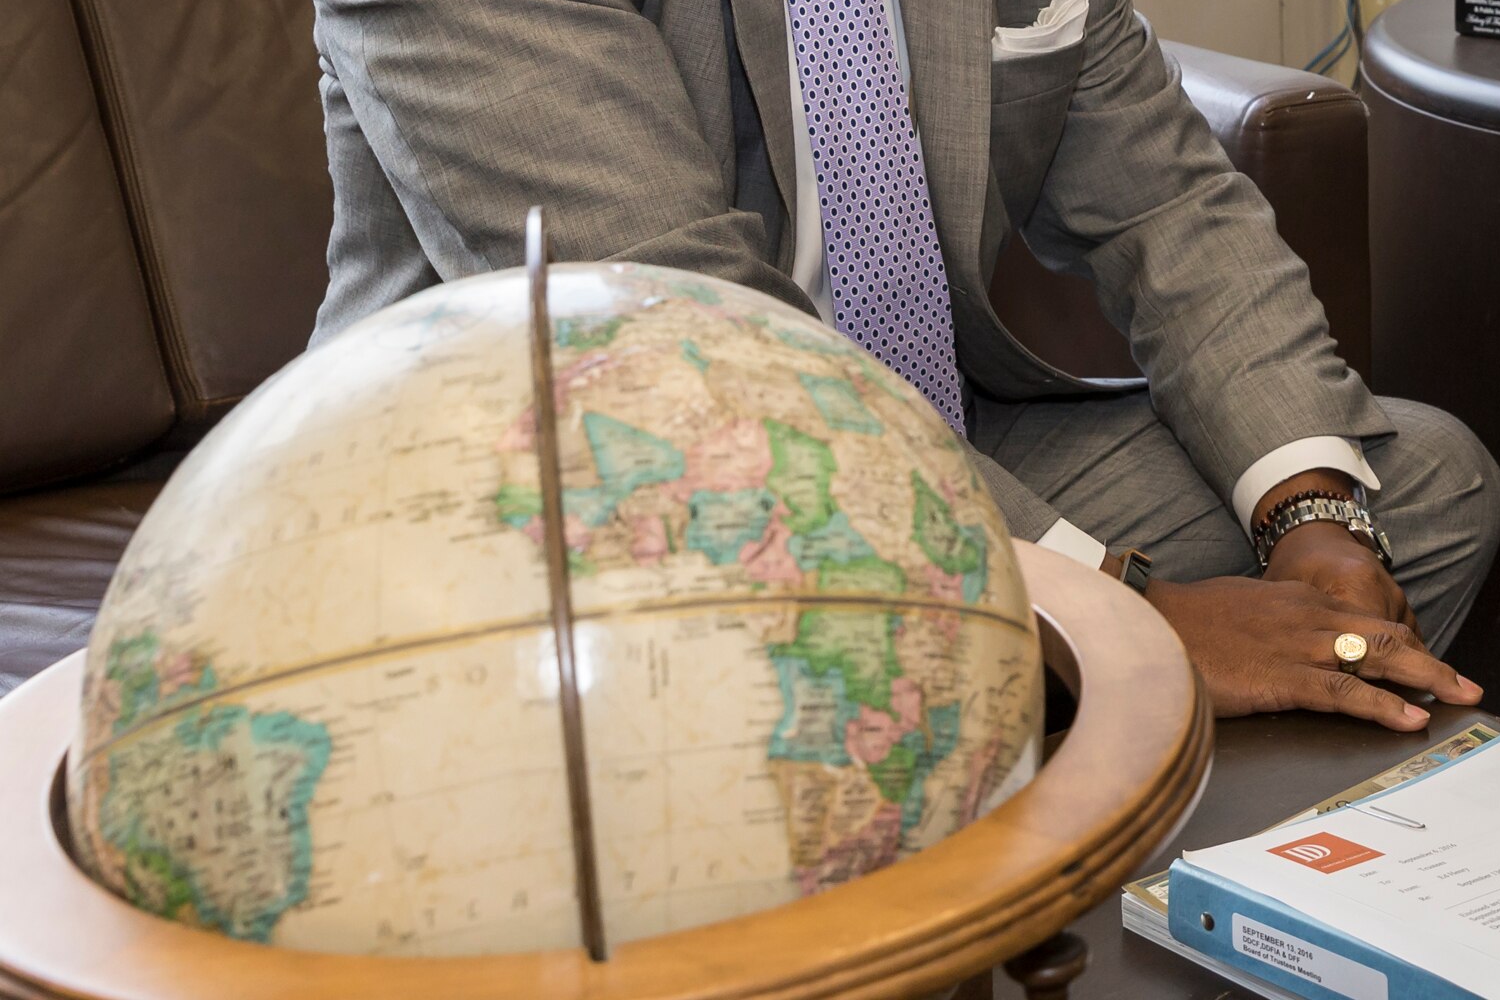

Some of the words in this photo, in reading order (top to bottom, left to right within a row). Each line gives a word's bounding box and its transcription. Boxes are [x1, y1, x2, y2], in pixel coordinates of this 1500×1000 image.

[1242, 925, 1285, 949] SEPTEMBER
[1297, 946, 1314, 961] 2016
[1282, 949, 1287, 959] &
[1288, 951, 1302, 964] DFF
[1243, 945, 1261, 958] Board
[1262, 951, 1270, 960] of
[1269, 953, 1297, 972] Trustees
[1297, 963, 1323, 983] Meeting
